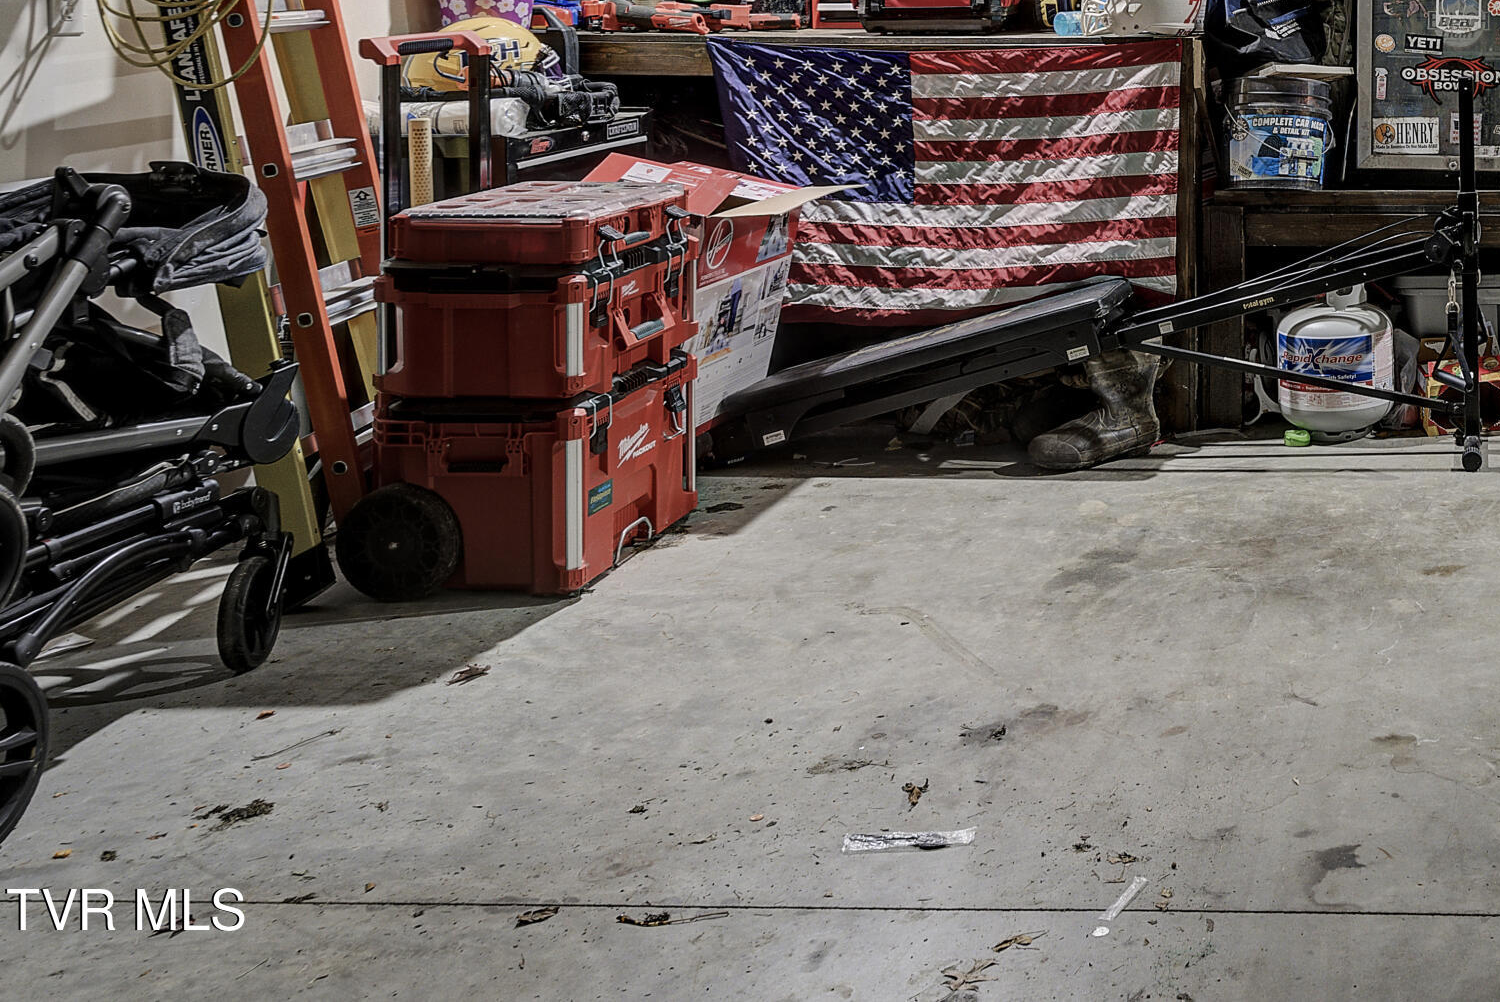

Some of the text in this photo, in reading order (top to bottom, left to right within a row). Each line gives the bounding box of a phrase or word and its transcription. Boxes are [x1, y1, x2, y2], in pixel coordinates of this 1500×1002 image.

[1438, 17, 1480, 27] Bear
[1406, 36, 1441, 50] YETI
[1434, 81, 1460, 90] BOW
[1252, 117, 1293, 127] COMPLETE
[1295, 118, 1309, 128] CAR
[1280, 127, 1300, 135] DETAIL
[1396, 122, 1434, 144] HENRY
[1259, 296, 1275, 306] gym
[1282, 351, 1311, 364] Rapid
